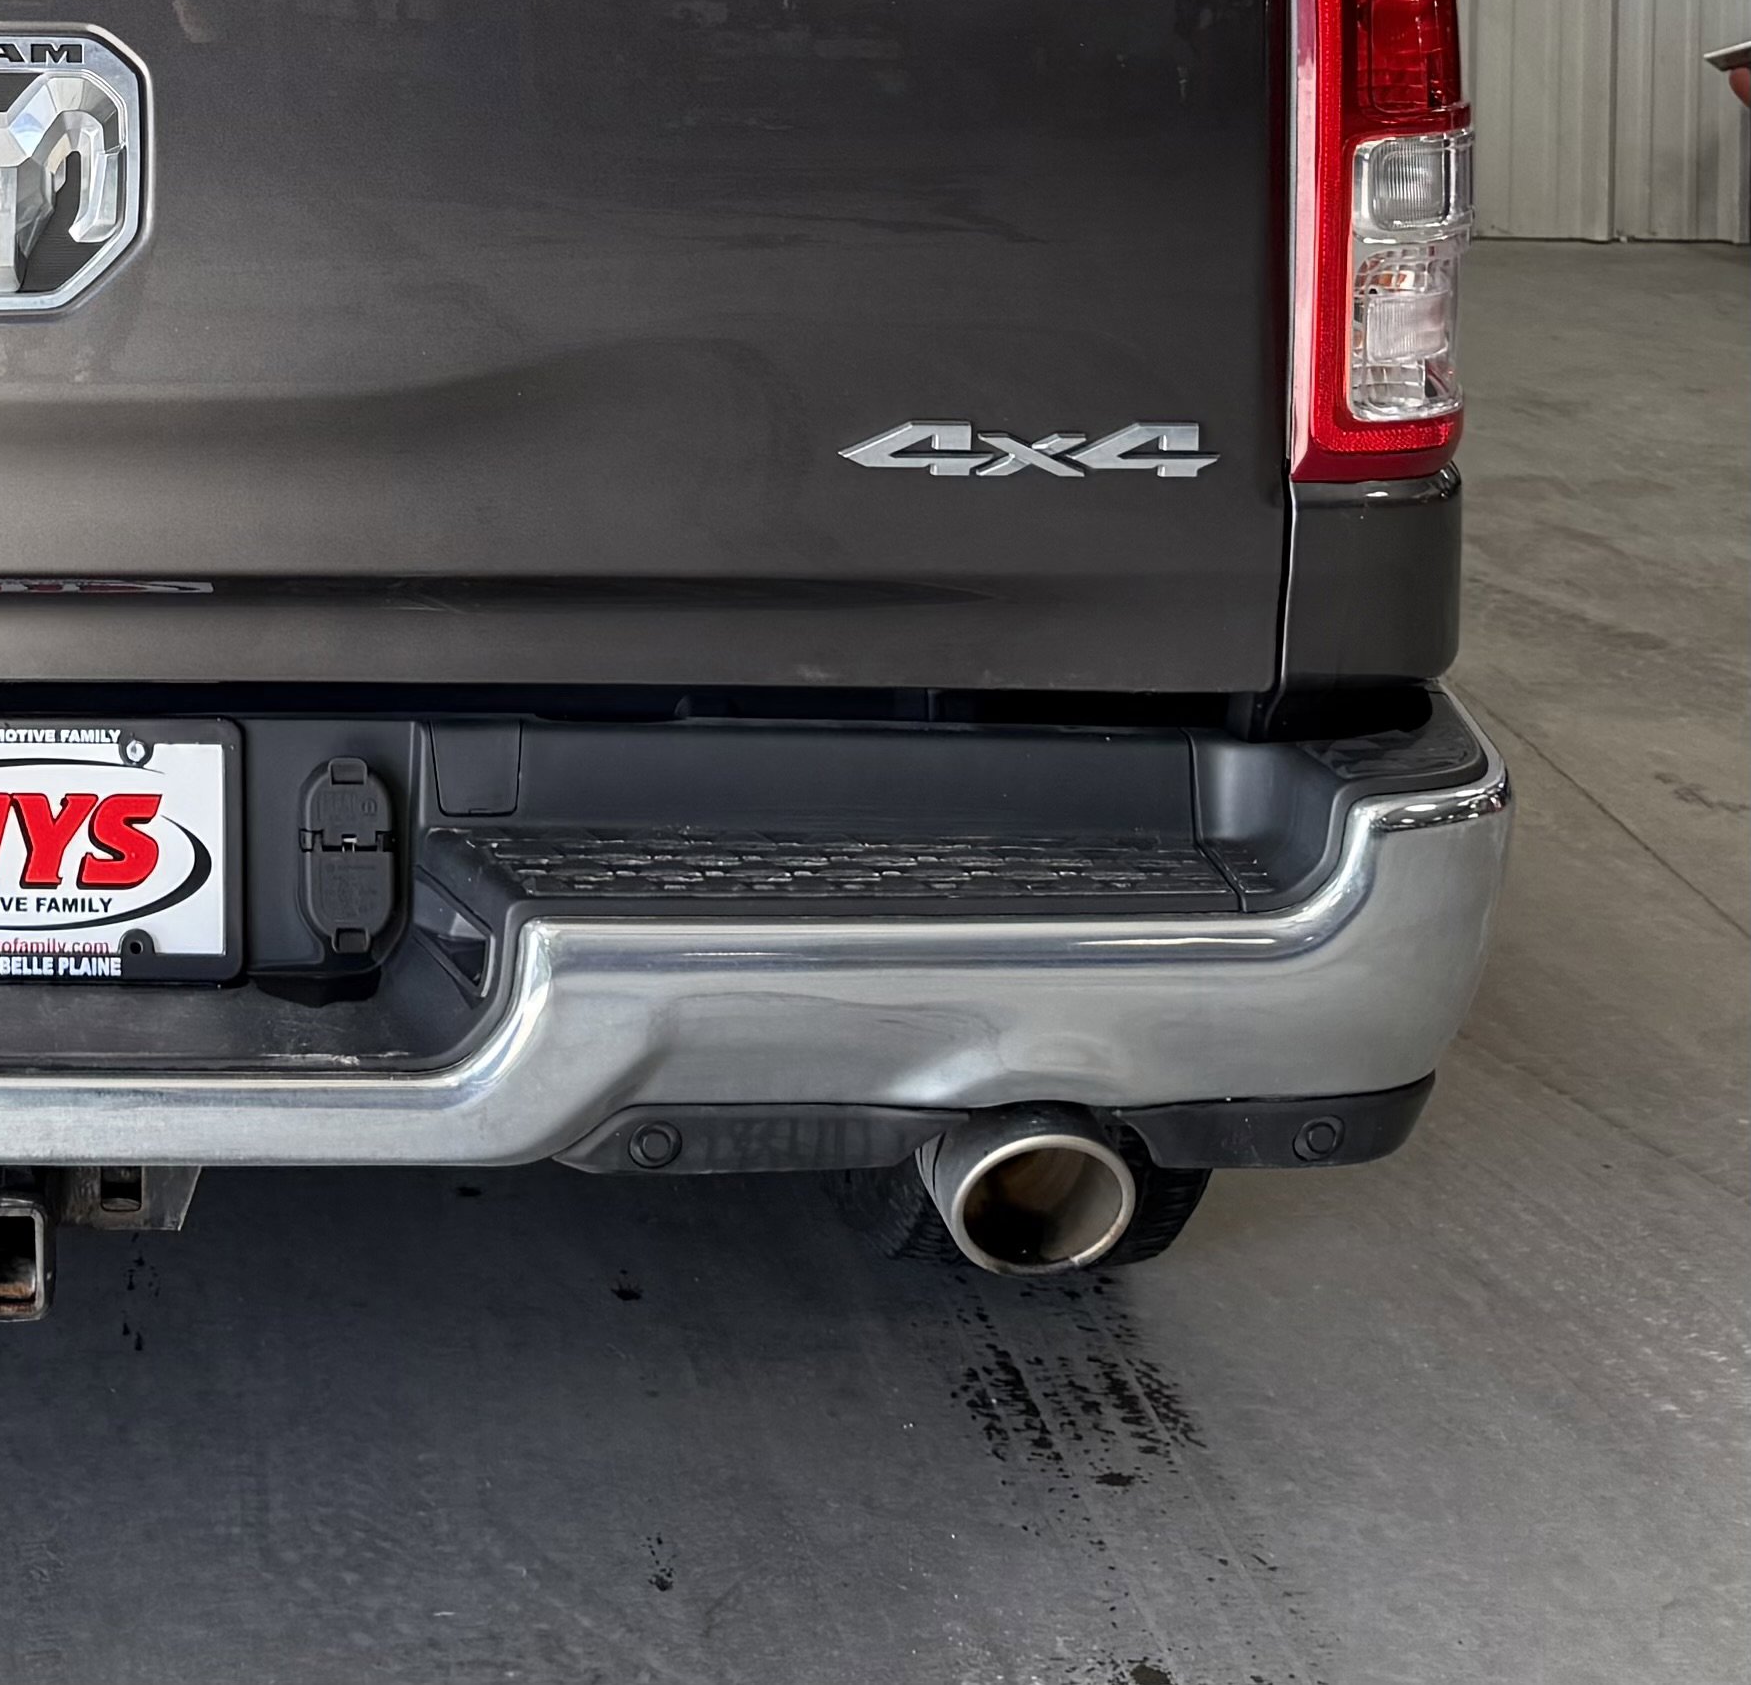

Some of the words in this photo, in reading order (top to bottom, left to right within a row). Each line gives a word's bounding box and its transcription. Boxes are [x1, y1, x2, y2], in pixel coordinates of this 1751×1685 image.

[60, 728, 121, 743] FAMILY
[35, 897, 113, 914] FAMILY
[0, 957, 54, 976] BELLE
[58, 957, 122, 977] PLAINE
